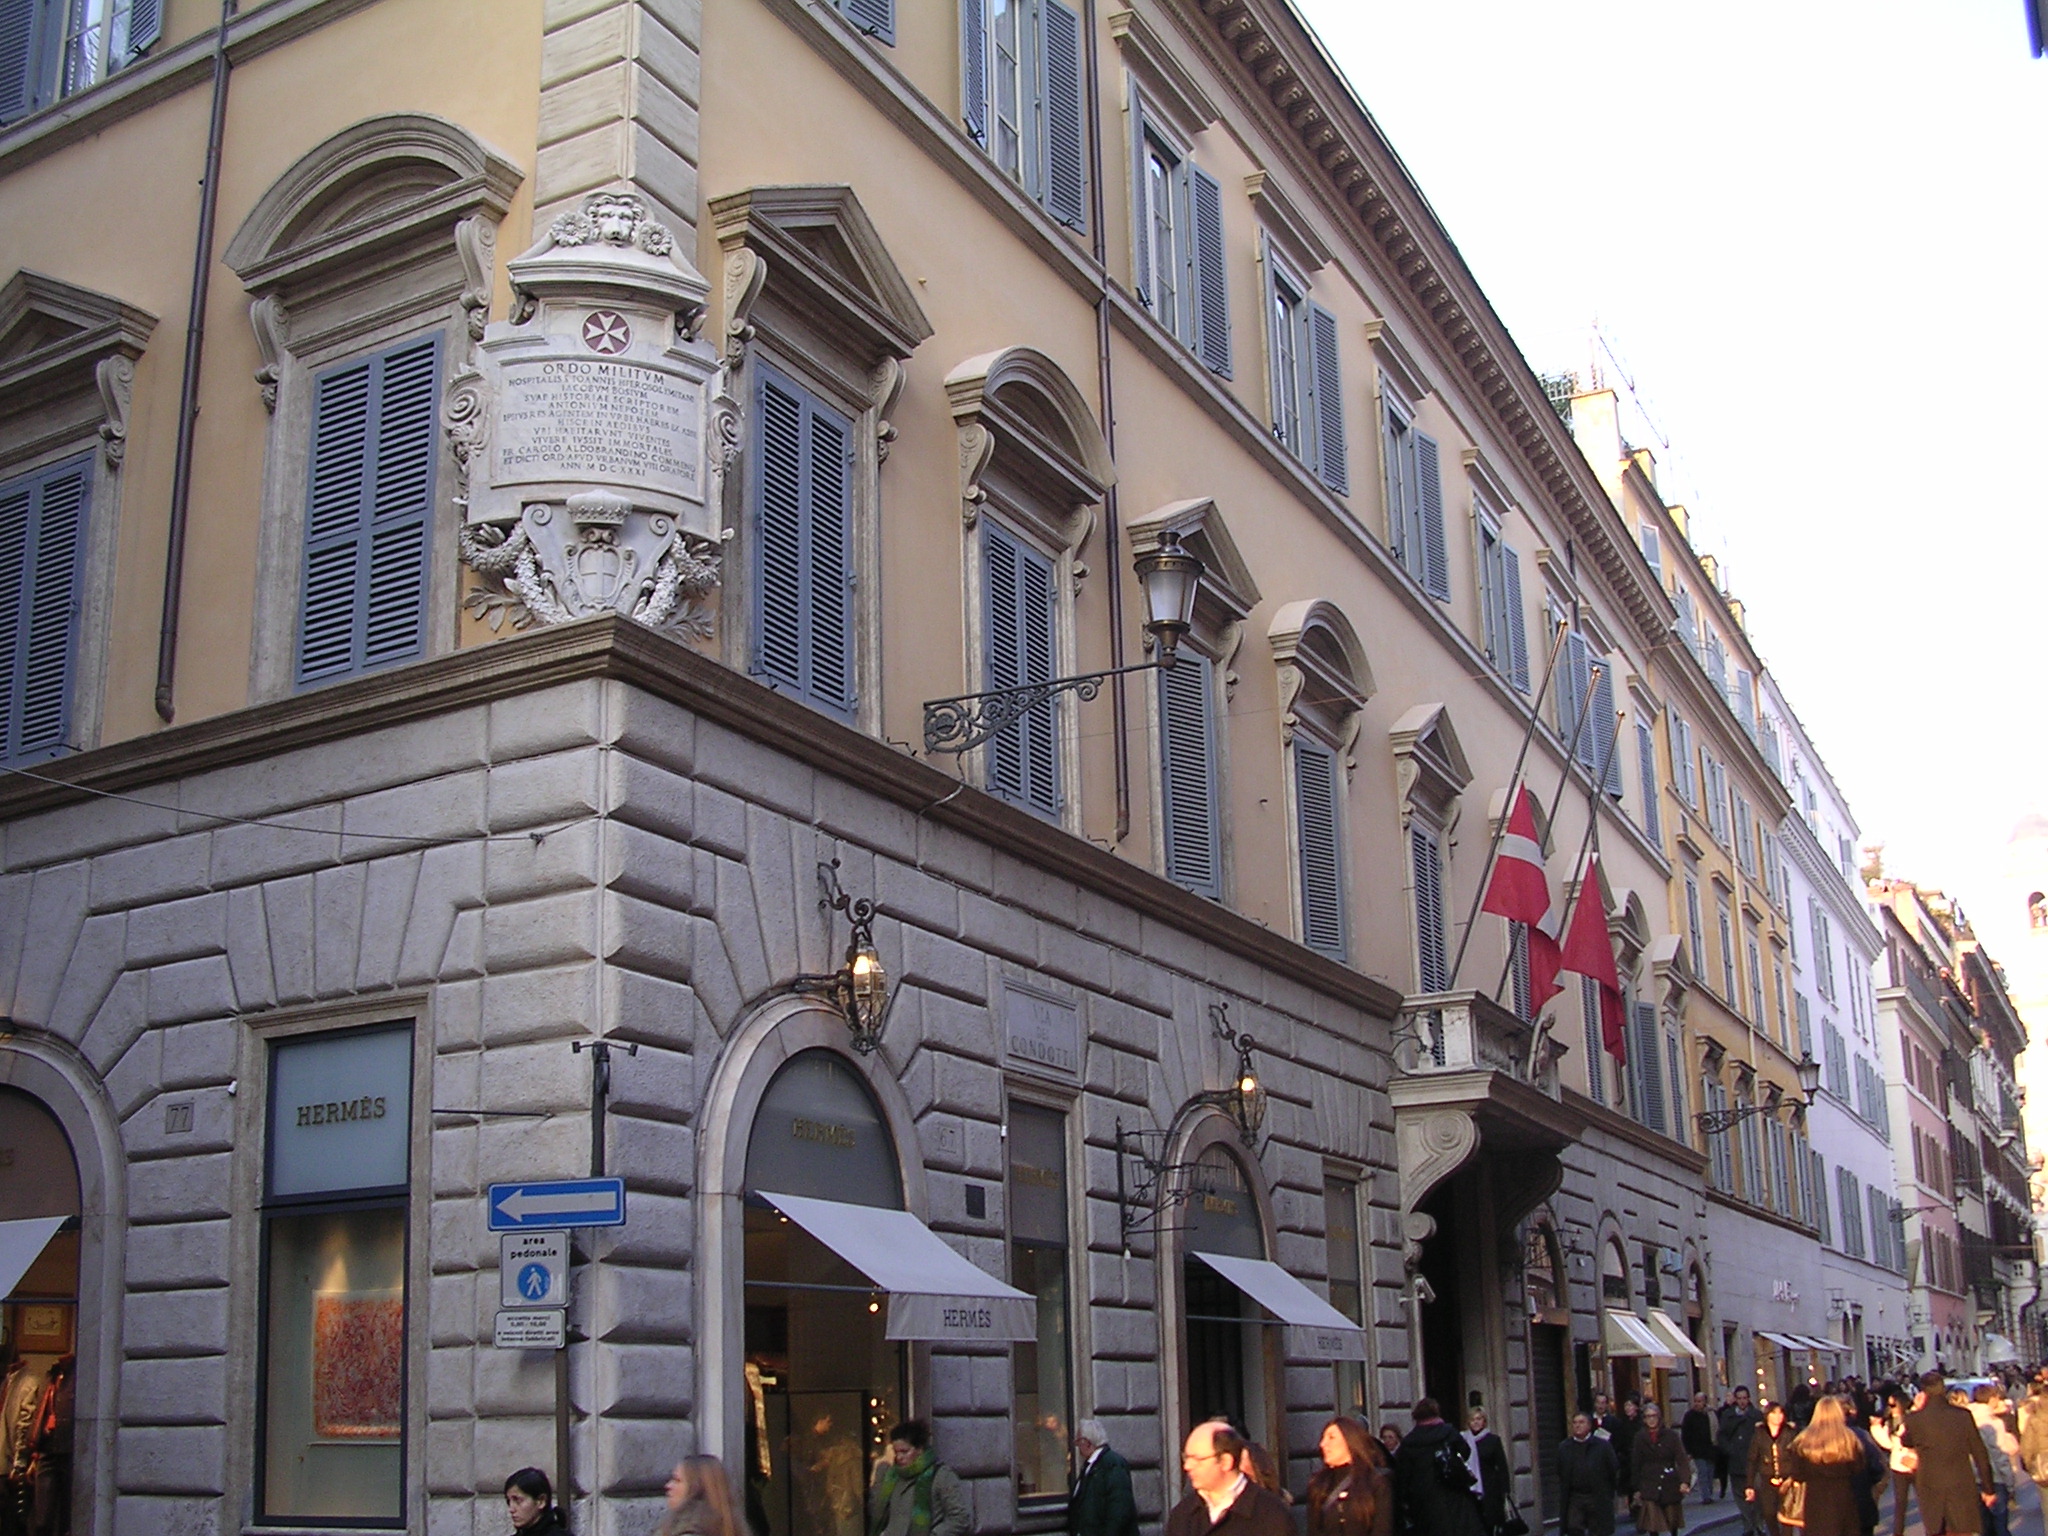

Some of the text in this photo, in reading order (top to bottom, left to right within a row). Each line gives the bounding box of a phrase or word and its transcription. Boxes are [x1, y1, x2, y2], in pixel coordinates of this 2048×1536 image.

[543, 363, 665, 386] ORDO MILITVM
[518, 444, 562, 455] CAROLO
[170, 1105, 190, 1130] 77
[522, 1237, 546, 1246] area
[510, 1248, 558, 1260] pedonale
